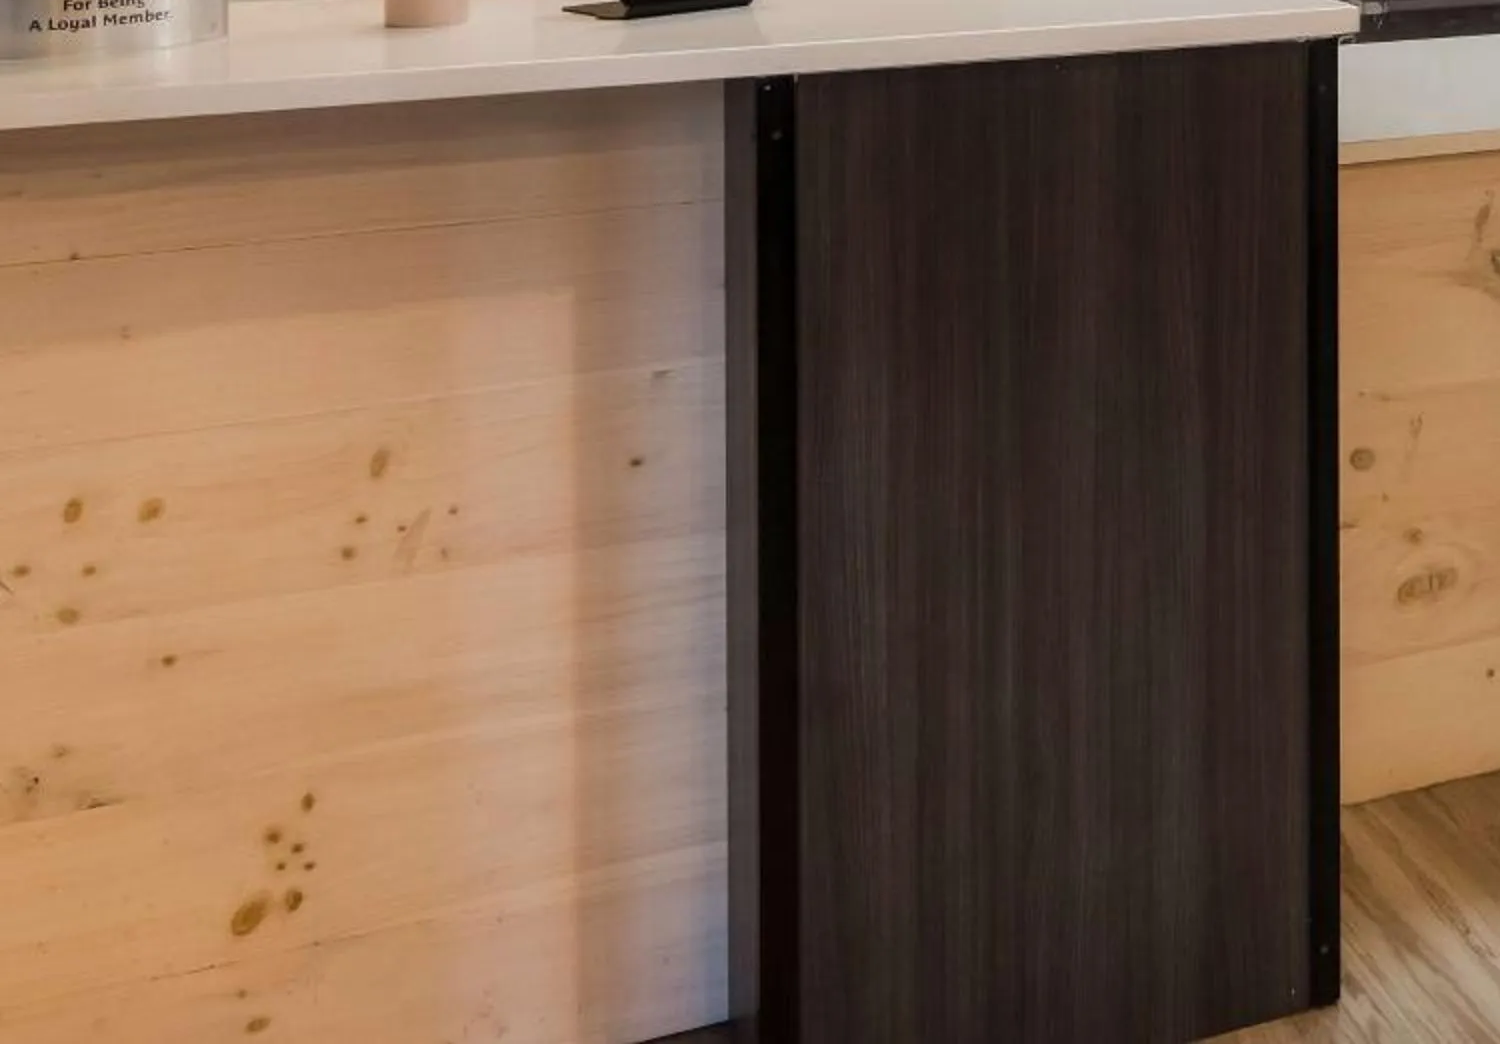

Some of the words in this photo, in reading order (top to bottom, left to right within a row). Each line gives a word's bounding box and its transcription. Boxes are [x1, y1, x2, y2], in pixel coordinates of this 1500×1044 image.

[29, 19, 42, 32] A
[49, 15, 97, 33] Loyal
[103, 9, 171, 27] Member
